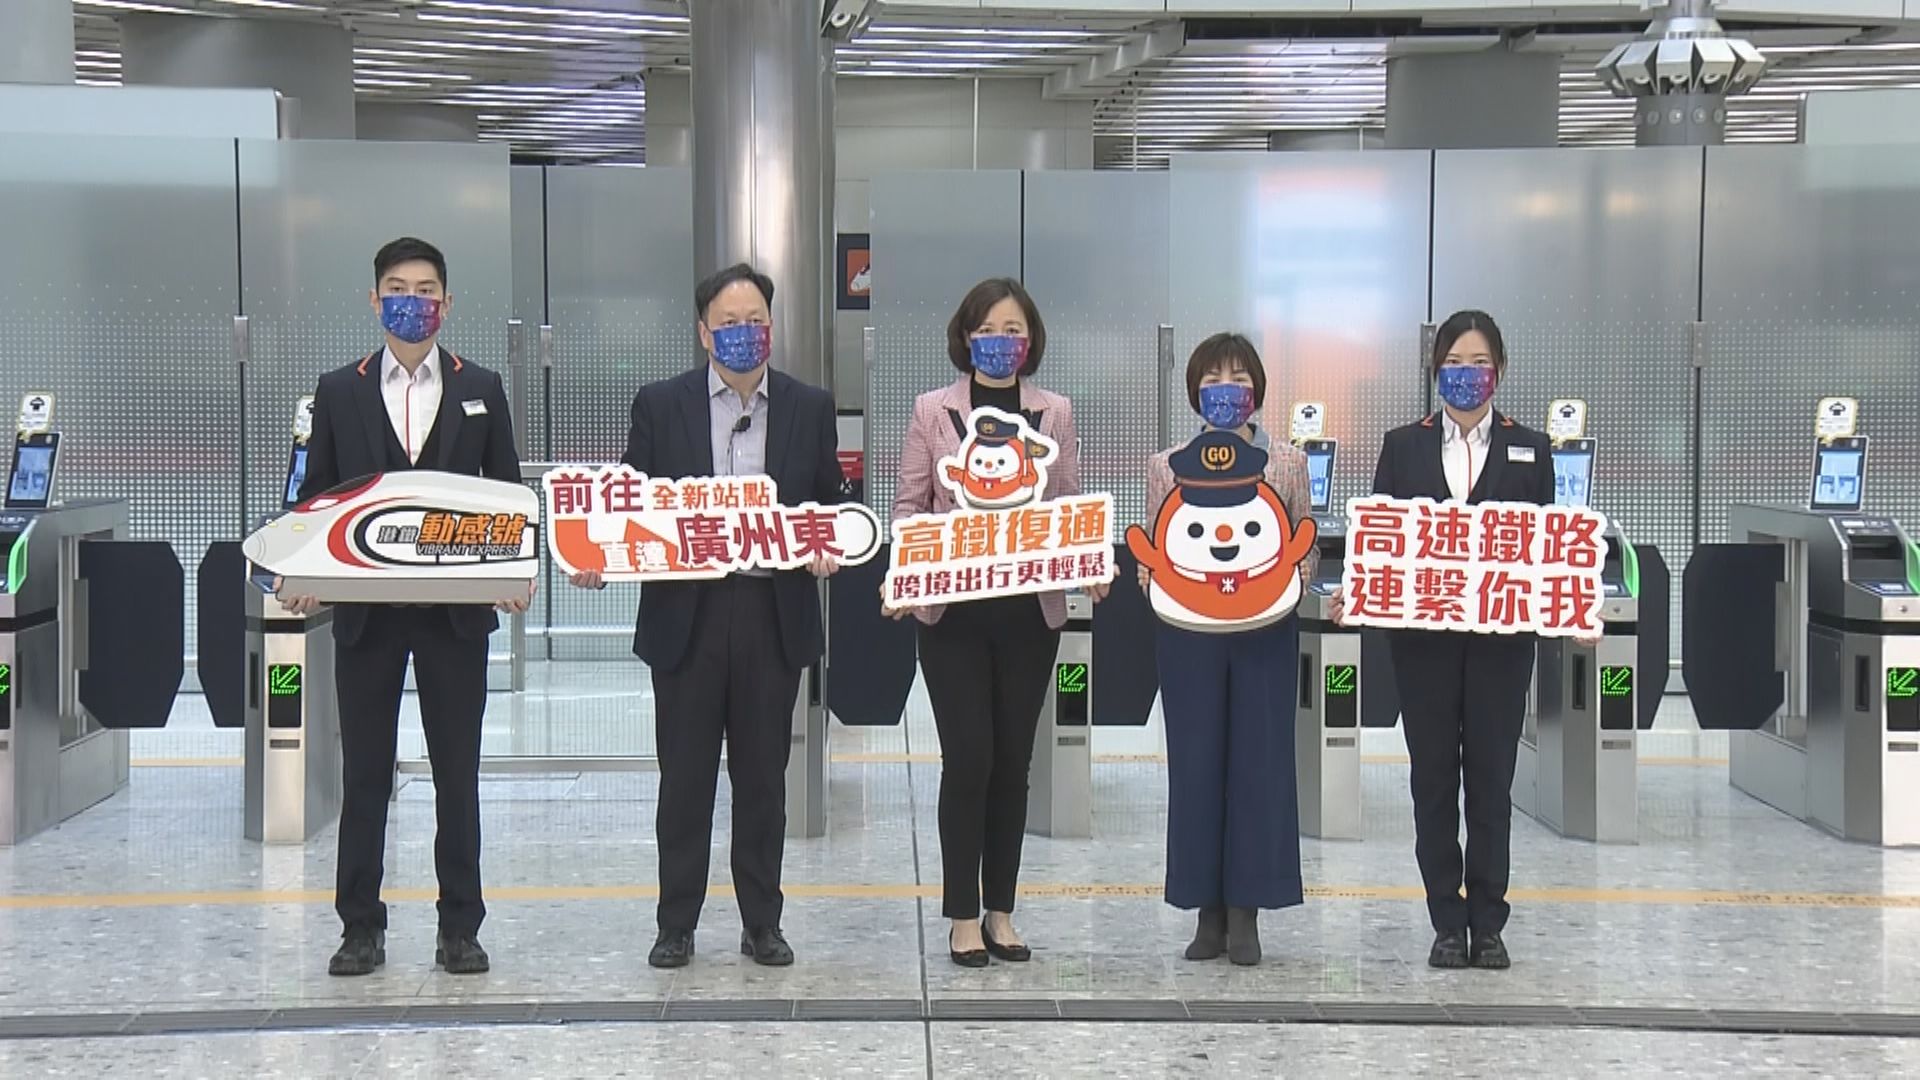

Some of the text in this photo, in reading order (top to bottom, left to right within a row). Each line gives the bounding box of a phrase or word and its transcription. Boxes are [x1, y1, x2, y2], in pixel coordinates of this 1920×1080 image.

[1207, 447, 1229, 462] GO
[551, 472, 770, 514] 前往 全新站點
[417, 512, 527, 544] 動感號
[675, 509, 844, 565] 廣州東
[898, 501, 1106, 566] 高鐵復通
[1354, 503, 1599, 568] 高速鐵路
[416, 545, 521, 556] VIBRANT EXPRESS
[600, 541, 670, 572] 直達
[893, 551, 1106, 600] 跨境出行更輕鬆
